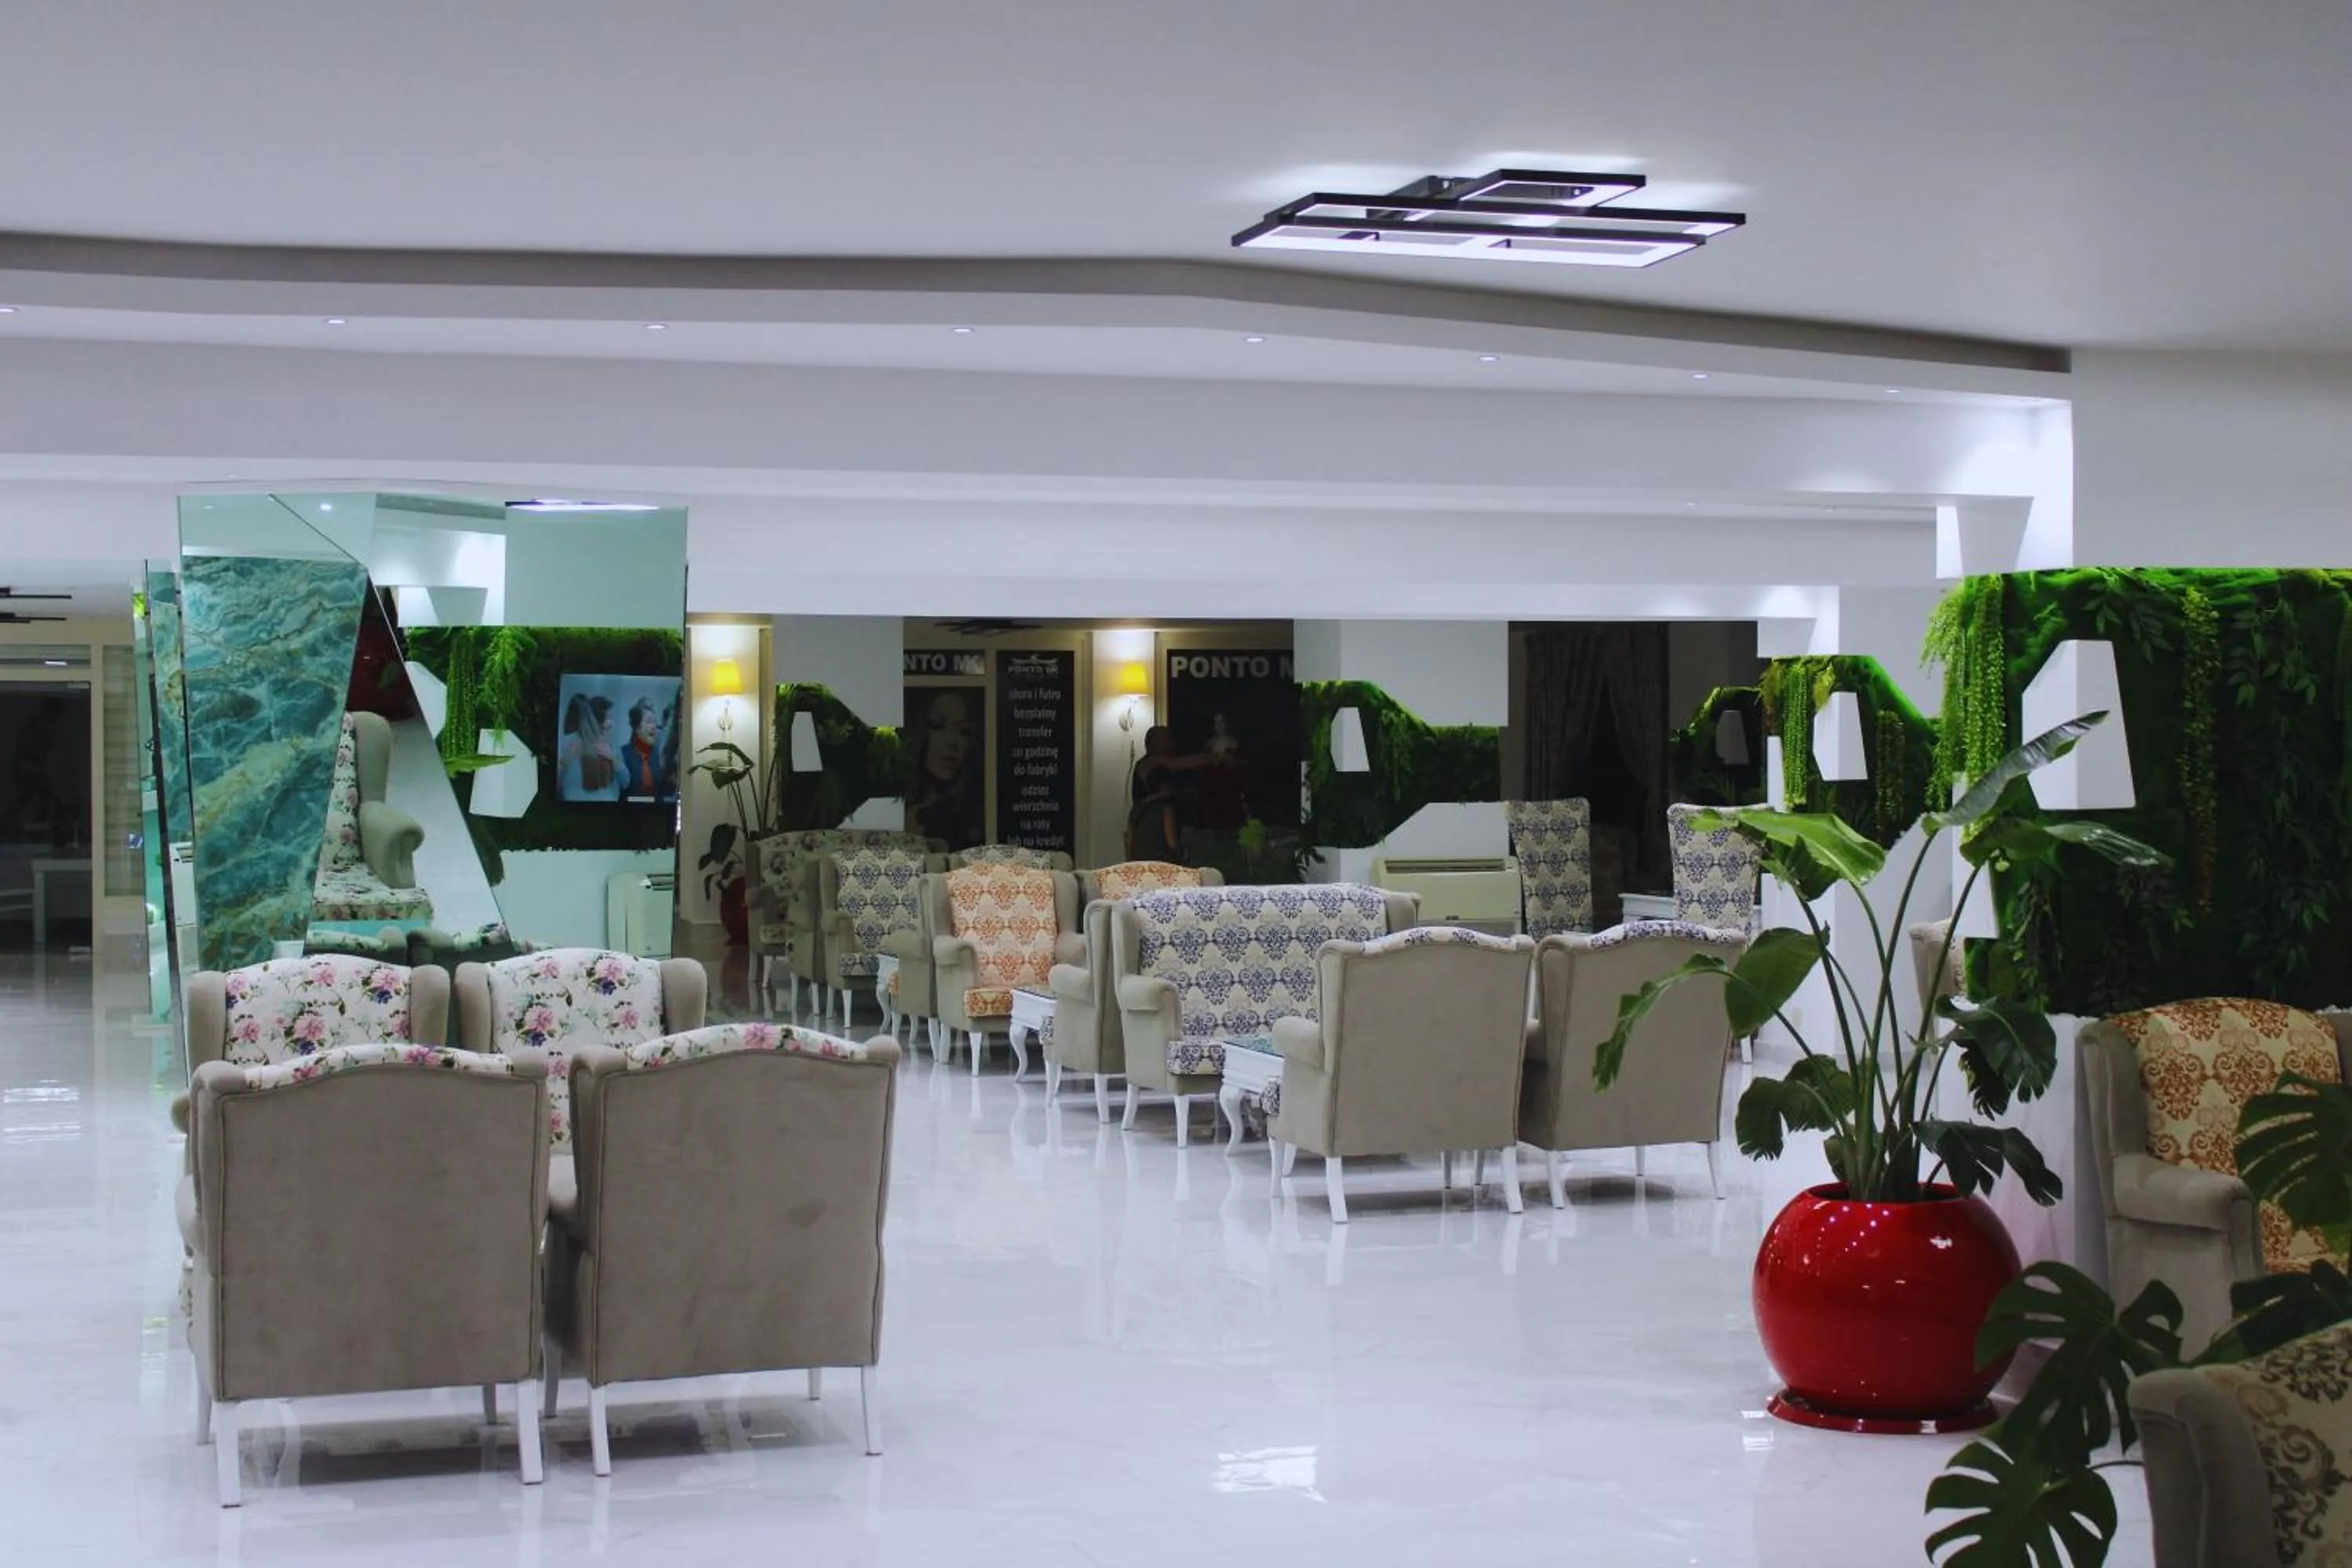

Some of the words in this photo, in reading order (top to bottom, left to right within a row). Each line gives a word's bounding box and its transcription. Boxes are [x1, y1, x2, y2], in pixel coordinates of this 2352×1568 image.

[1171, 656, 1270, 678] PONTO
[1039, 688, 1062, 699] futro
[1018, 726, 1053, 738] transfer
